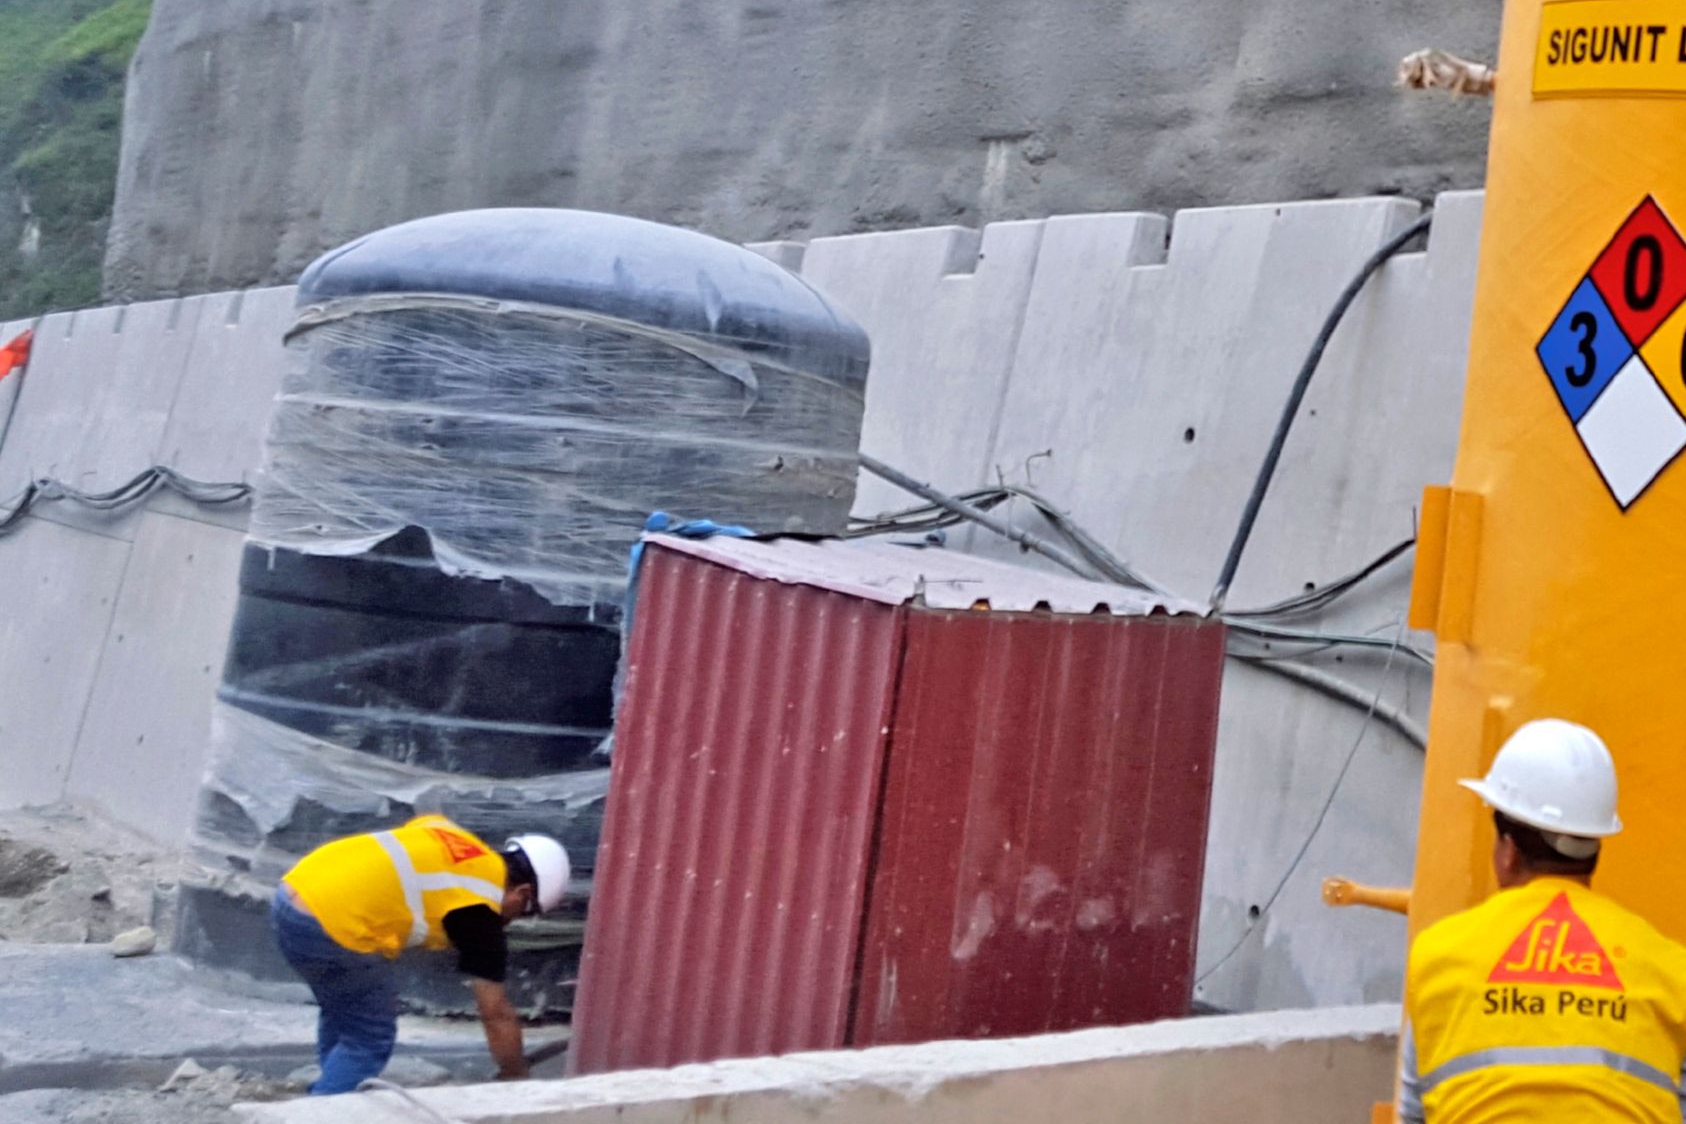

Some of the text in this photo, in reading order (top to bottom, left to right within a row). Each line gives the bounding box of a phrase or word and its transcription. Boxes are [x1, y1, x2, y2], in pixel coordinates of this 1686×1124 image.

[1547, 25, 1666, 65] SIGUNIT
[1624, 235, 1662, 311] 0
[1565, 311, 1598, 388] 3
[1507, 919, 1602, 976] Sika
[1483, 988, 1628, 1023] Sika Perú
